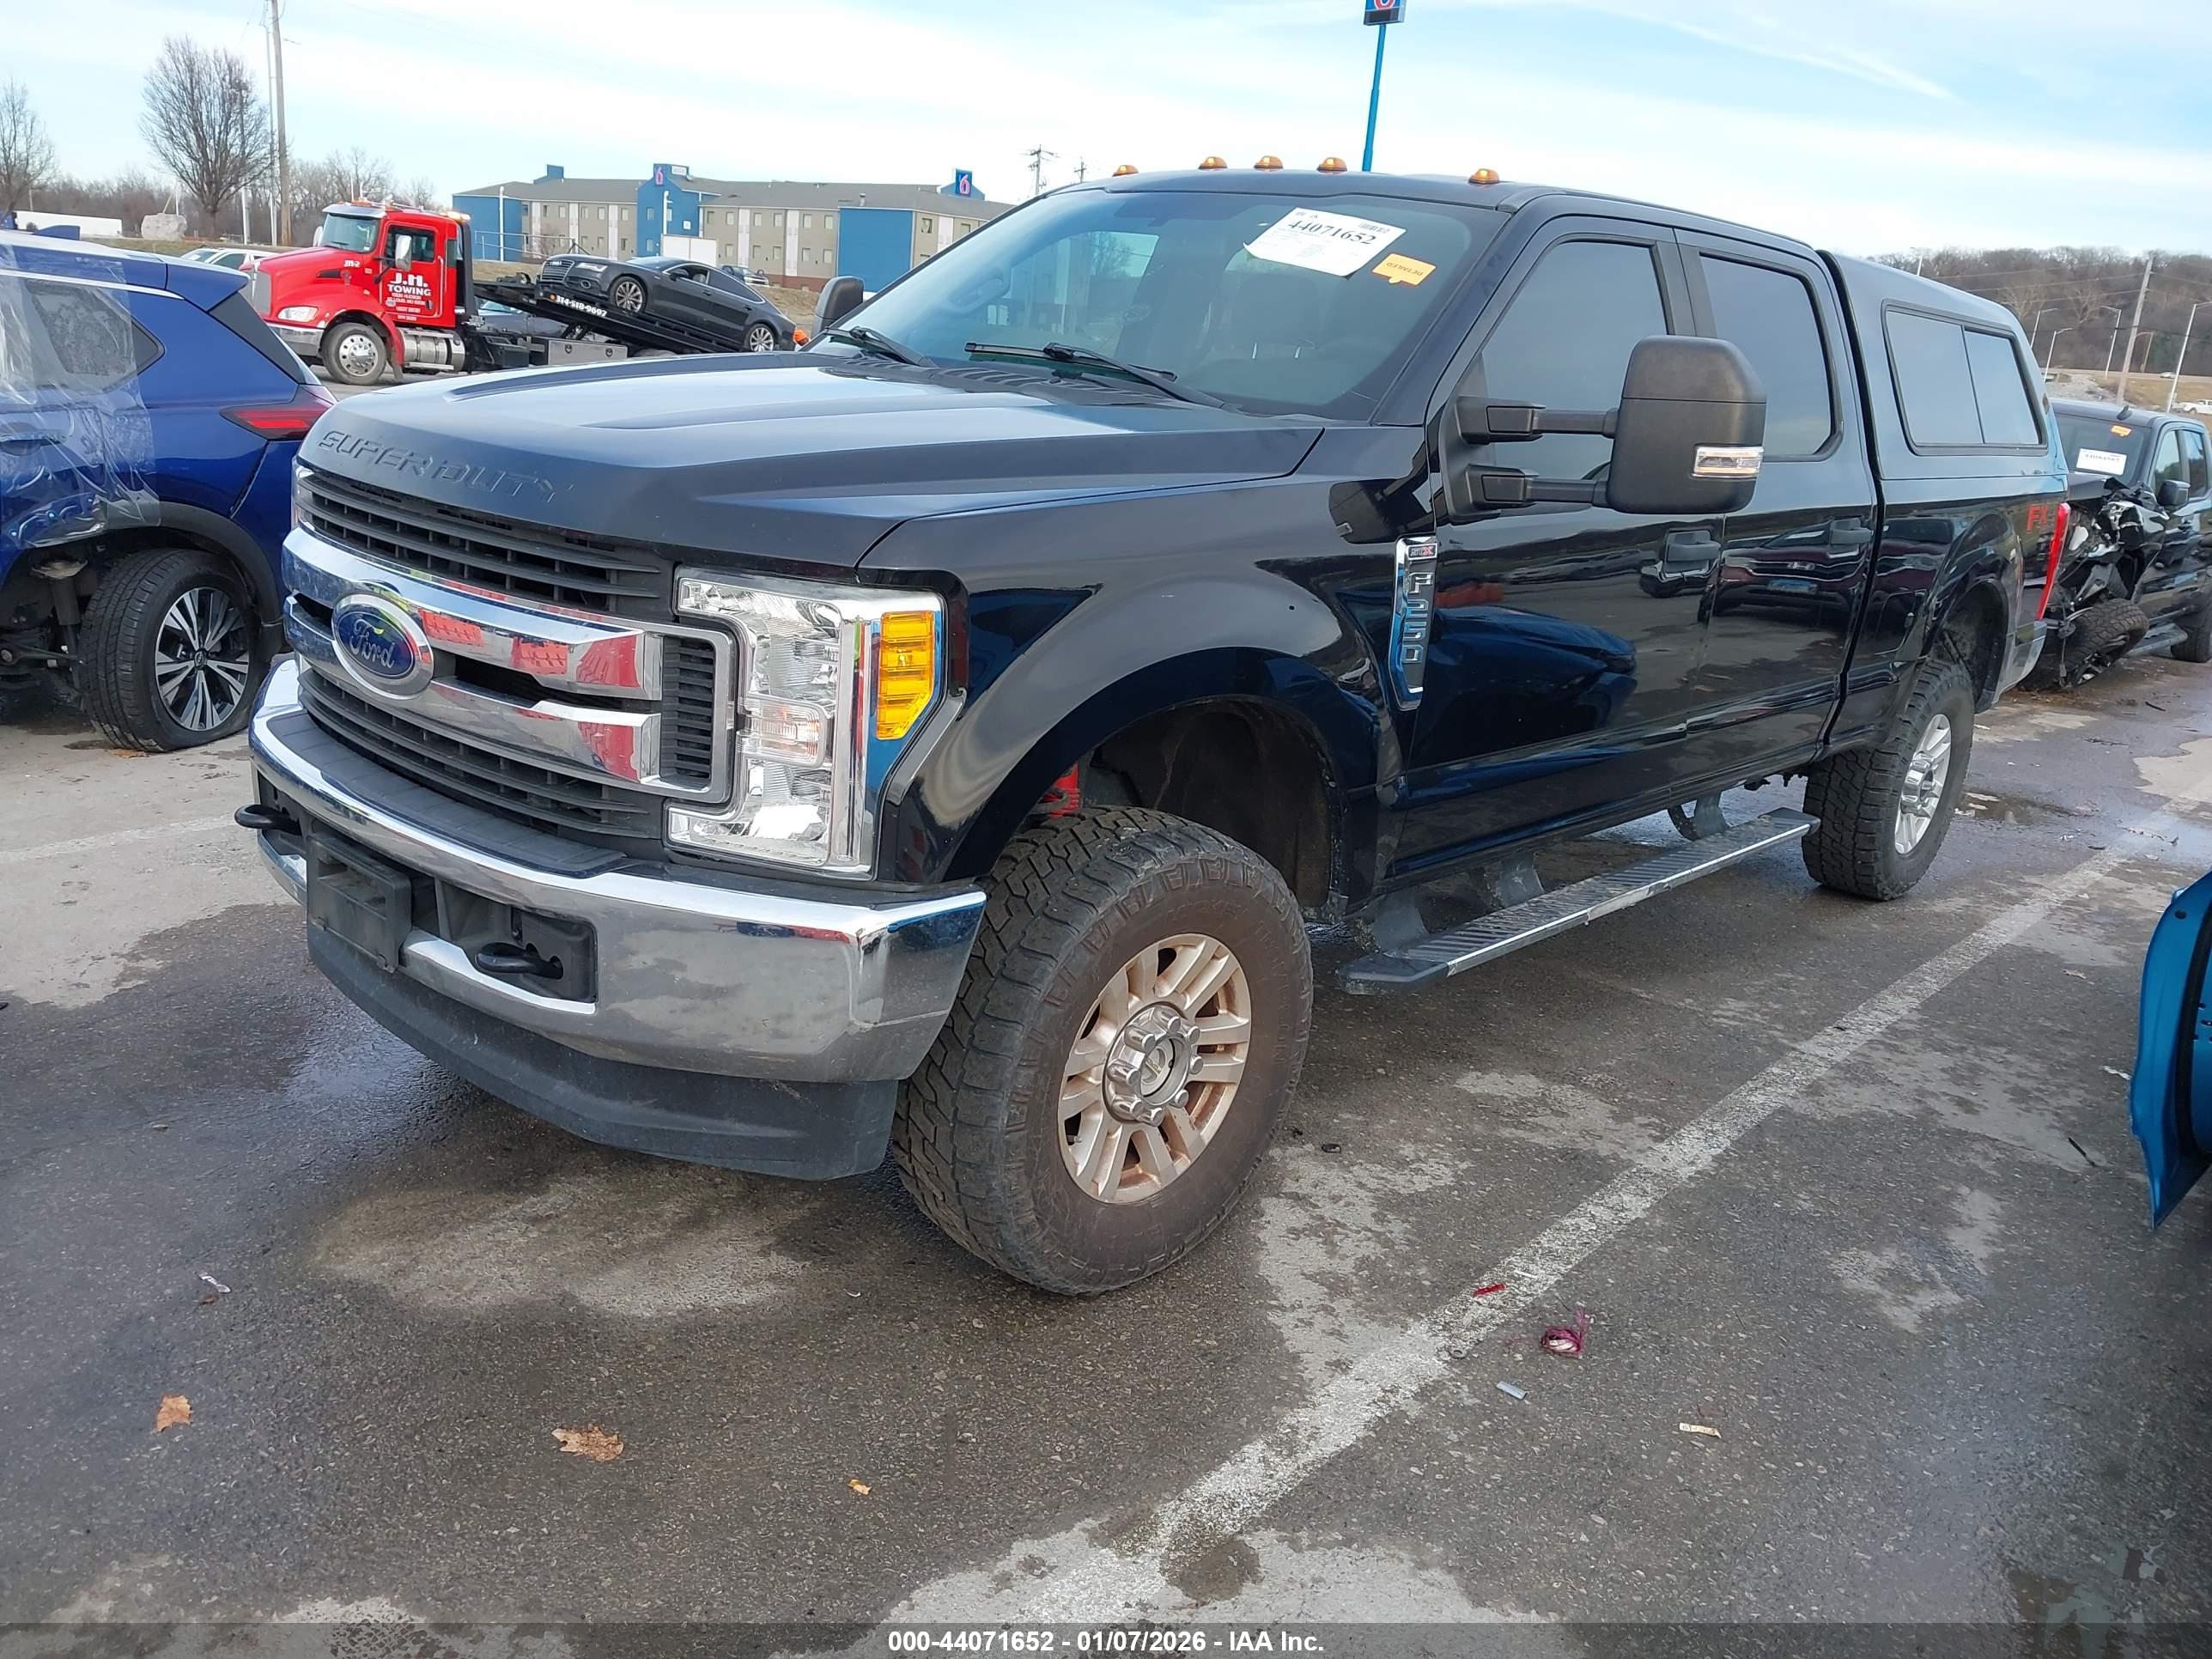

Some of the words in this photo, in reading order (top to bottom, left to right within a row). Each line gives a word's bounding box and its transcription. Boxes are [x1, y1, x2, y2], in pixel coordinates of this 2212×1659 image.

[655, 166, 664, 185] 6
[959, 173, 970, 194] 6
[1288, 220, 1376, 245] 44071652
[387, 283, 432, 296] TOWING
[389, 272, 429, 288] J.H.
[318, 429, 434, 477] SUPER
[432, 459, 574, 503] DUTY
[1411, 546, 1434, 557] STX
[1401, 572, 1435, 664] F250
[349, 618, 397, 669] Ford
